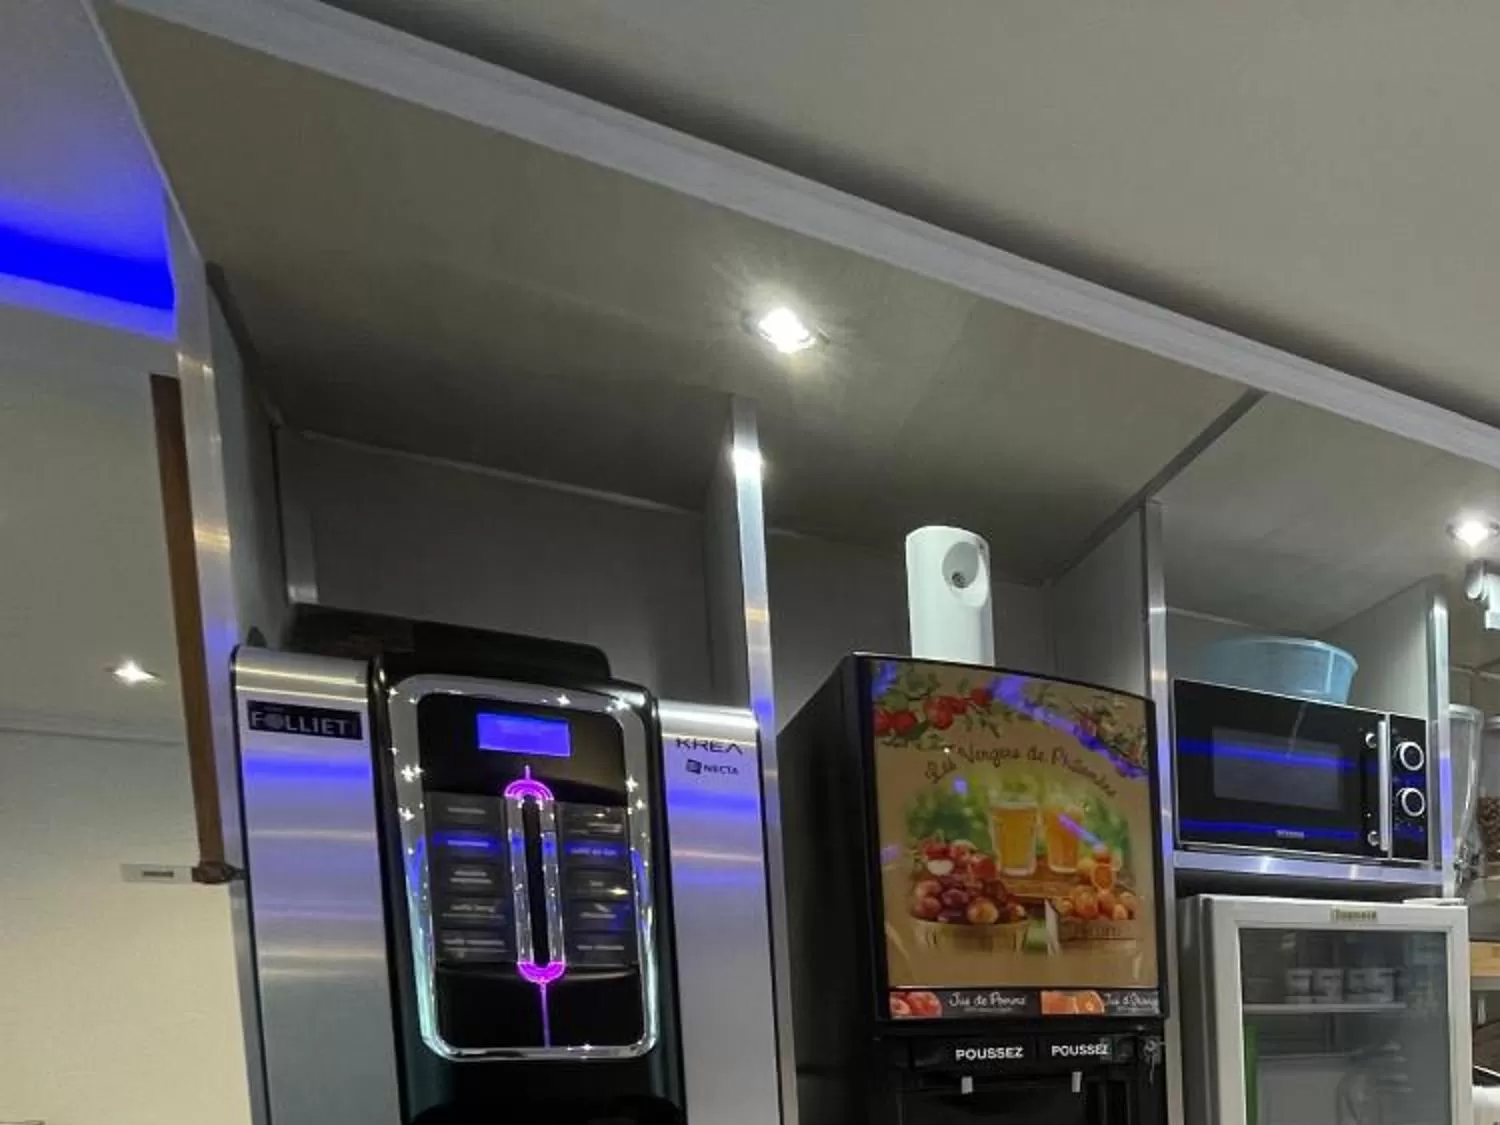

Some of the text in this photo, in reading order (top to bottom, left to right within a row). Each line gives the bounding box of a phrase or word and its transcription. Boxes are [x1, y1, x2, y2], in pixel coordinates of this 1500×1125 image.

[251, 711, 346, 736] FOLLIET
[675, 737, 743, 755] KREA
[955, 1045, 1024, 1061] POUSSEZ
[1051, 1042, 1110, 1057] POUSSEZ
